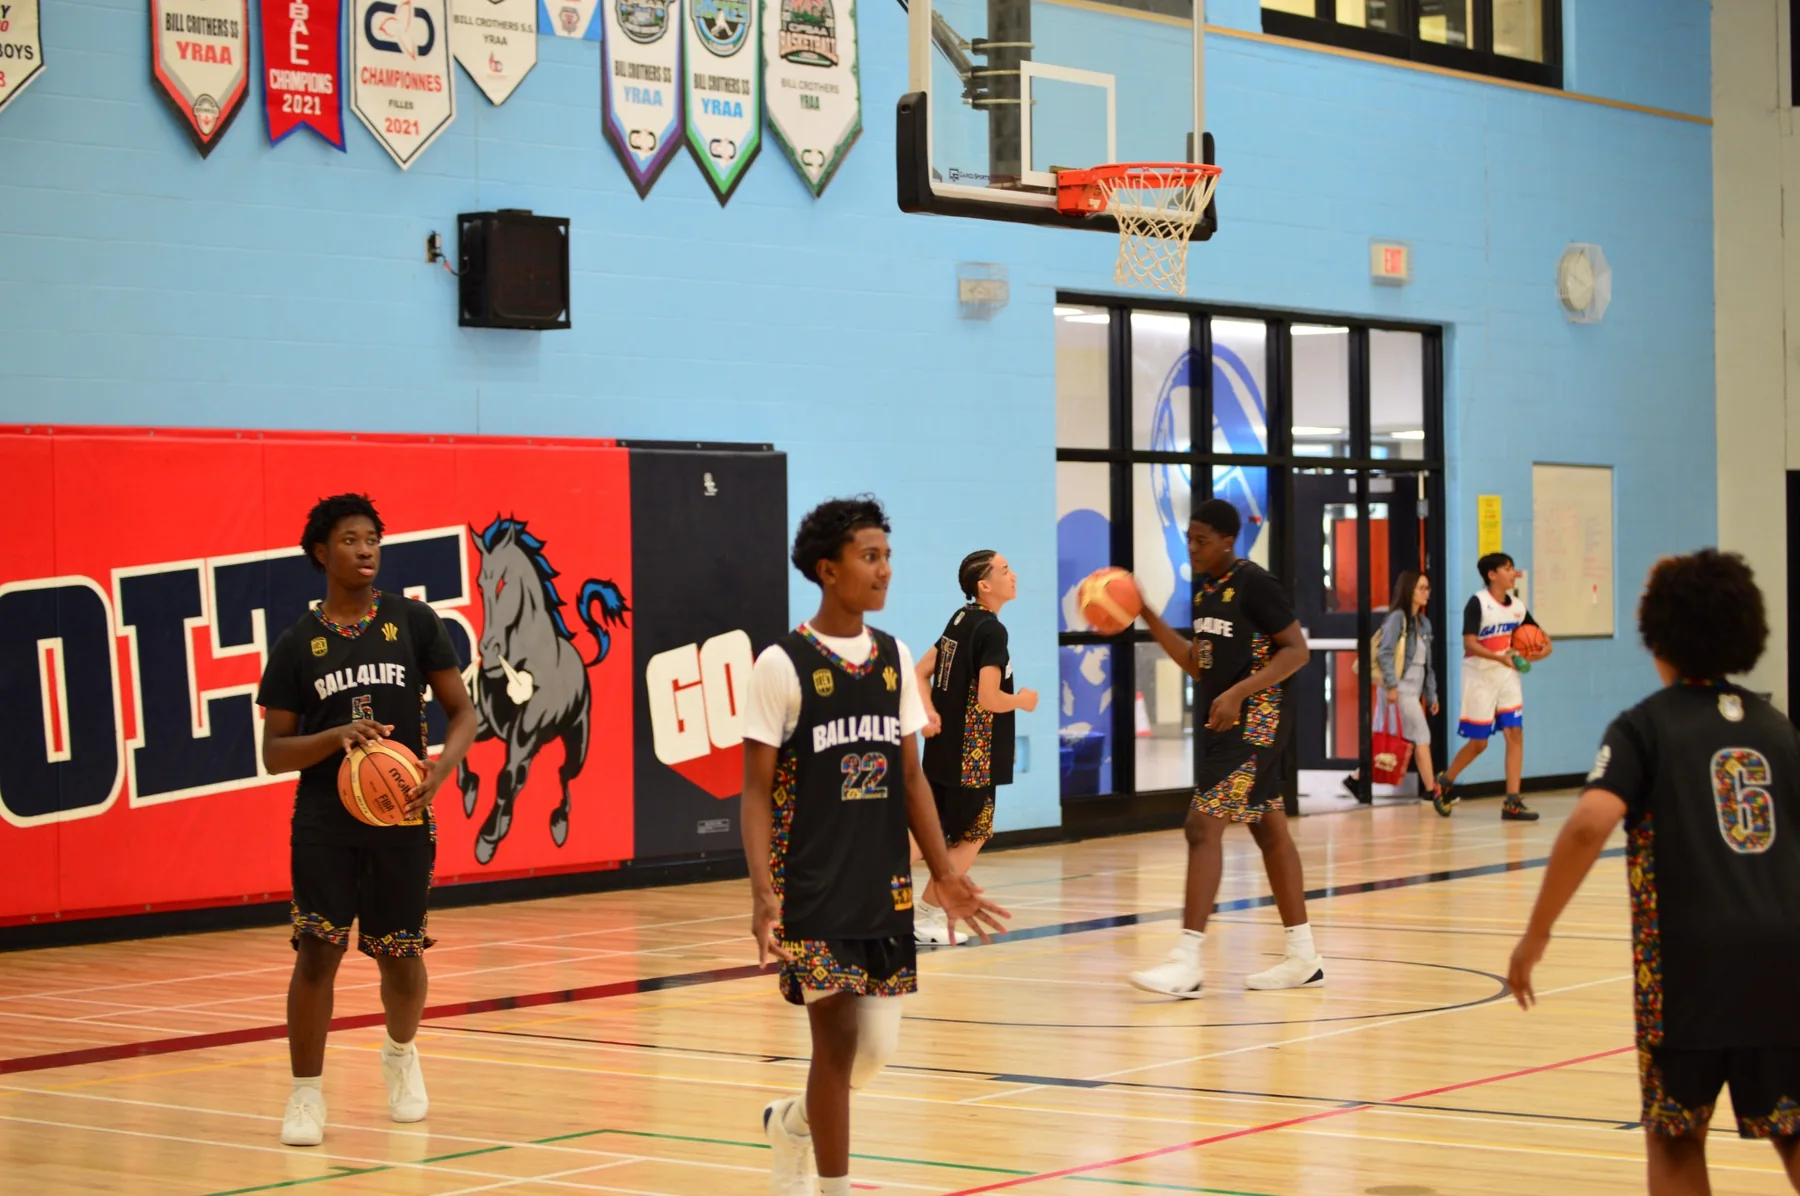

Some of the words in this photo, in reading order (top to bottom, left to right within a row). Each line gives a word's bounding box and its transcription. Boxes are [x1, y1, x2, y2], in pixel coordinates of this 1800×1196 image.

[165, 12, 185, 33] BILL
[186, 14, 229, 38] CROTHERS
[230, 20, 239, 39] SS
[453, 14, 473, 26] BILL
[475, 17, 519, 31] CROTHERS
[482, 34, 508, 46] YRAA
[176, 41, 233, 65] YRAA
[269, 68, 333, 95] CHAMPIONS
[360, 66, 443, 93] CHAMPIONNES
[614, 60, 627, 78] BILL
[628, 62, 662, 83] CROTHERS
[663, 66, 672, 84] SS
[623, 86, 663, 107] YRAA
[694, 73, 707, 91] BILL
[708, 75, 741, 95] CROTHERS
[742, 79, 751, 96] SS
[781, 77, 797, 88] BILL
[799, 80, 839, 95] CROTHERS
[282, 93, 322, 116] 2021
[701, 98, 744, 119] YRAA
[384, 116, 421, 136] 2021
[314, 662, 406, 701] BALL4LIFE
[351, 694, 374, 724] 5
[646, 629, 755, 766] GO
[841, 752, 888, 801] 22
[1710, 747, 1776, 854] 6
